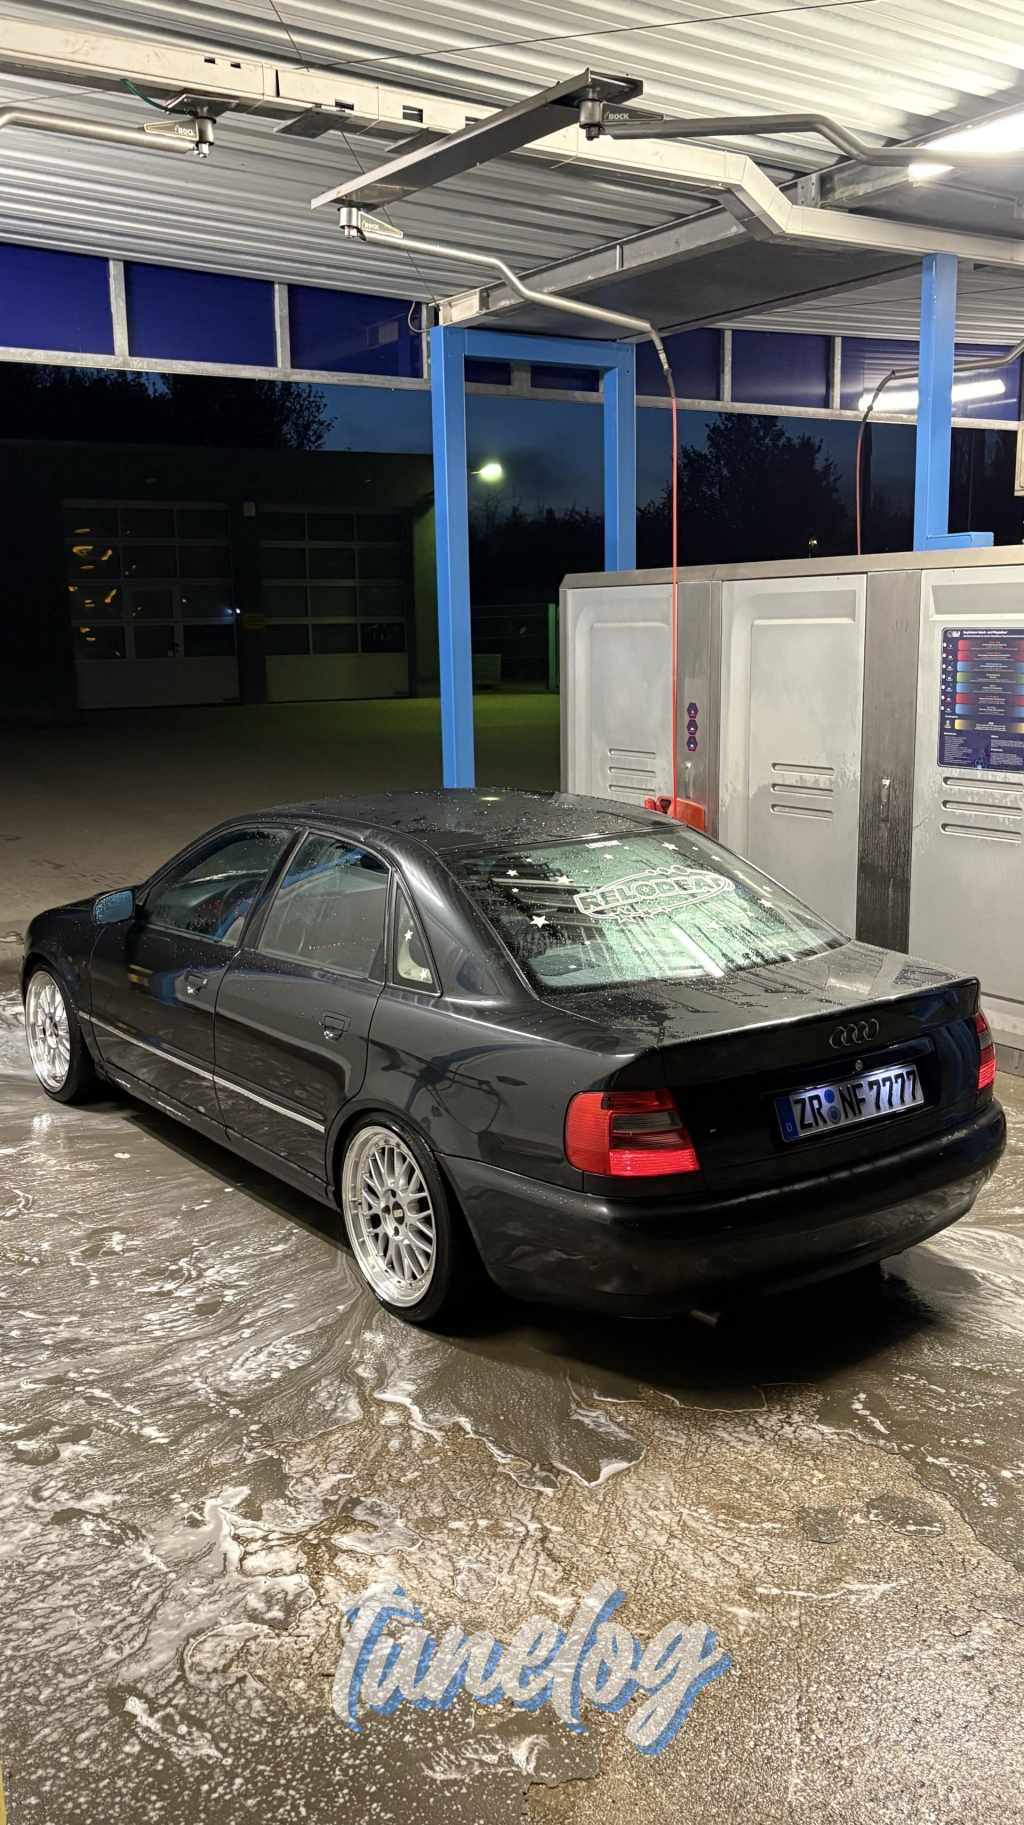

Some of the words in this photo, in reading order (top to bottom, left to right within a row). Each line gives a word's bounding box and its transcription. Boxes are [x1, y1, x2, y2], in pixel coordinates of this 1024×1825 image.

[608, 112, 630, 120] BOCK
[792, 1094, 828, 1130] ZR
[837, 1083, 867, 1119] NF
[868, 1069, 917, 1111] 7777
